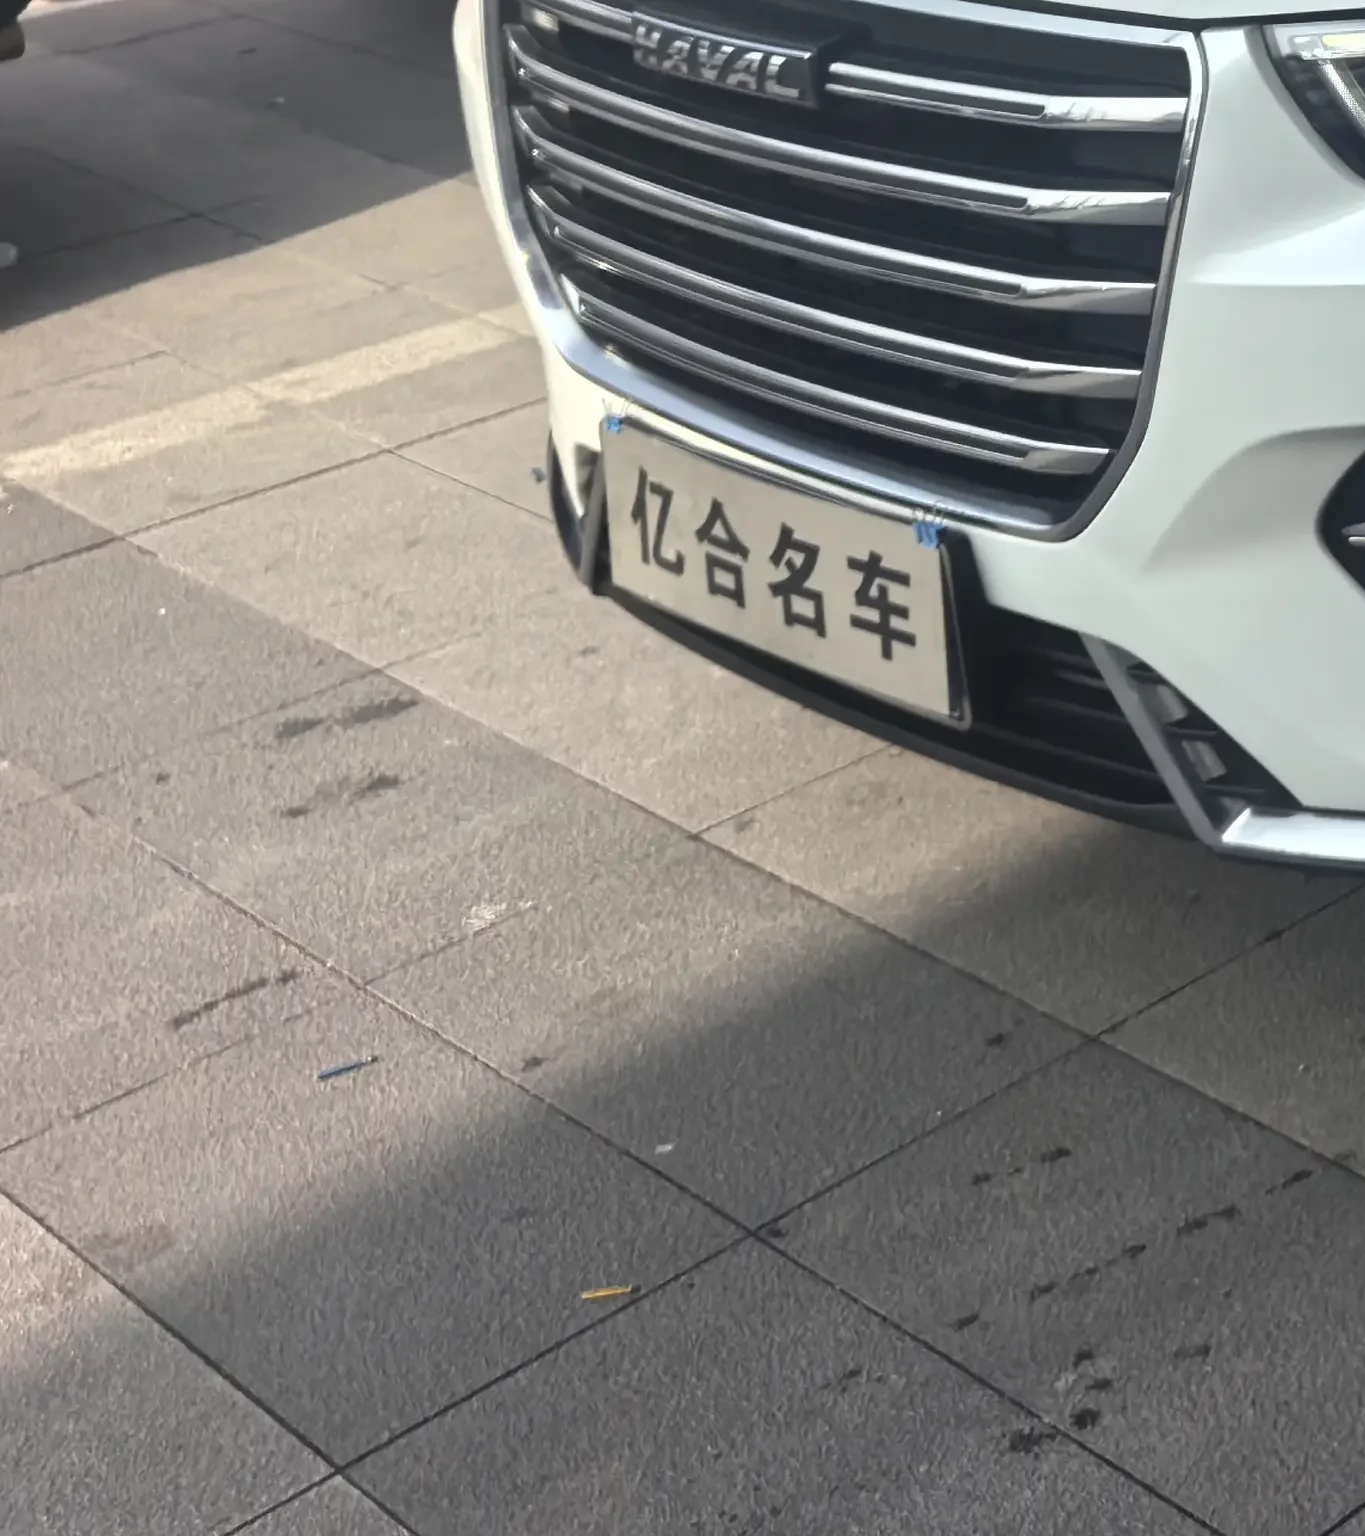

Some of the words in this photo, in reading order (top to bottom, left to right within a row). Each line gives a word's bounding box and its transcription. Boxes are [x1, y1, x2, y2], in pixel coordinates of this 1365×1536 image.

[632, 23, 801, 99] HAVAL
[631, 465, 917, 661] 亿合名车
